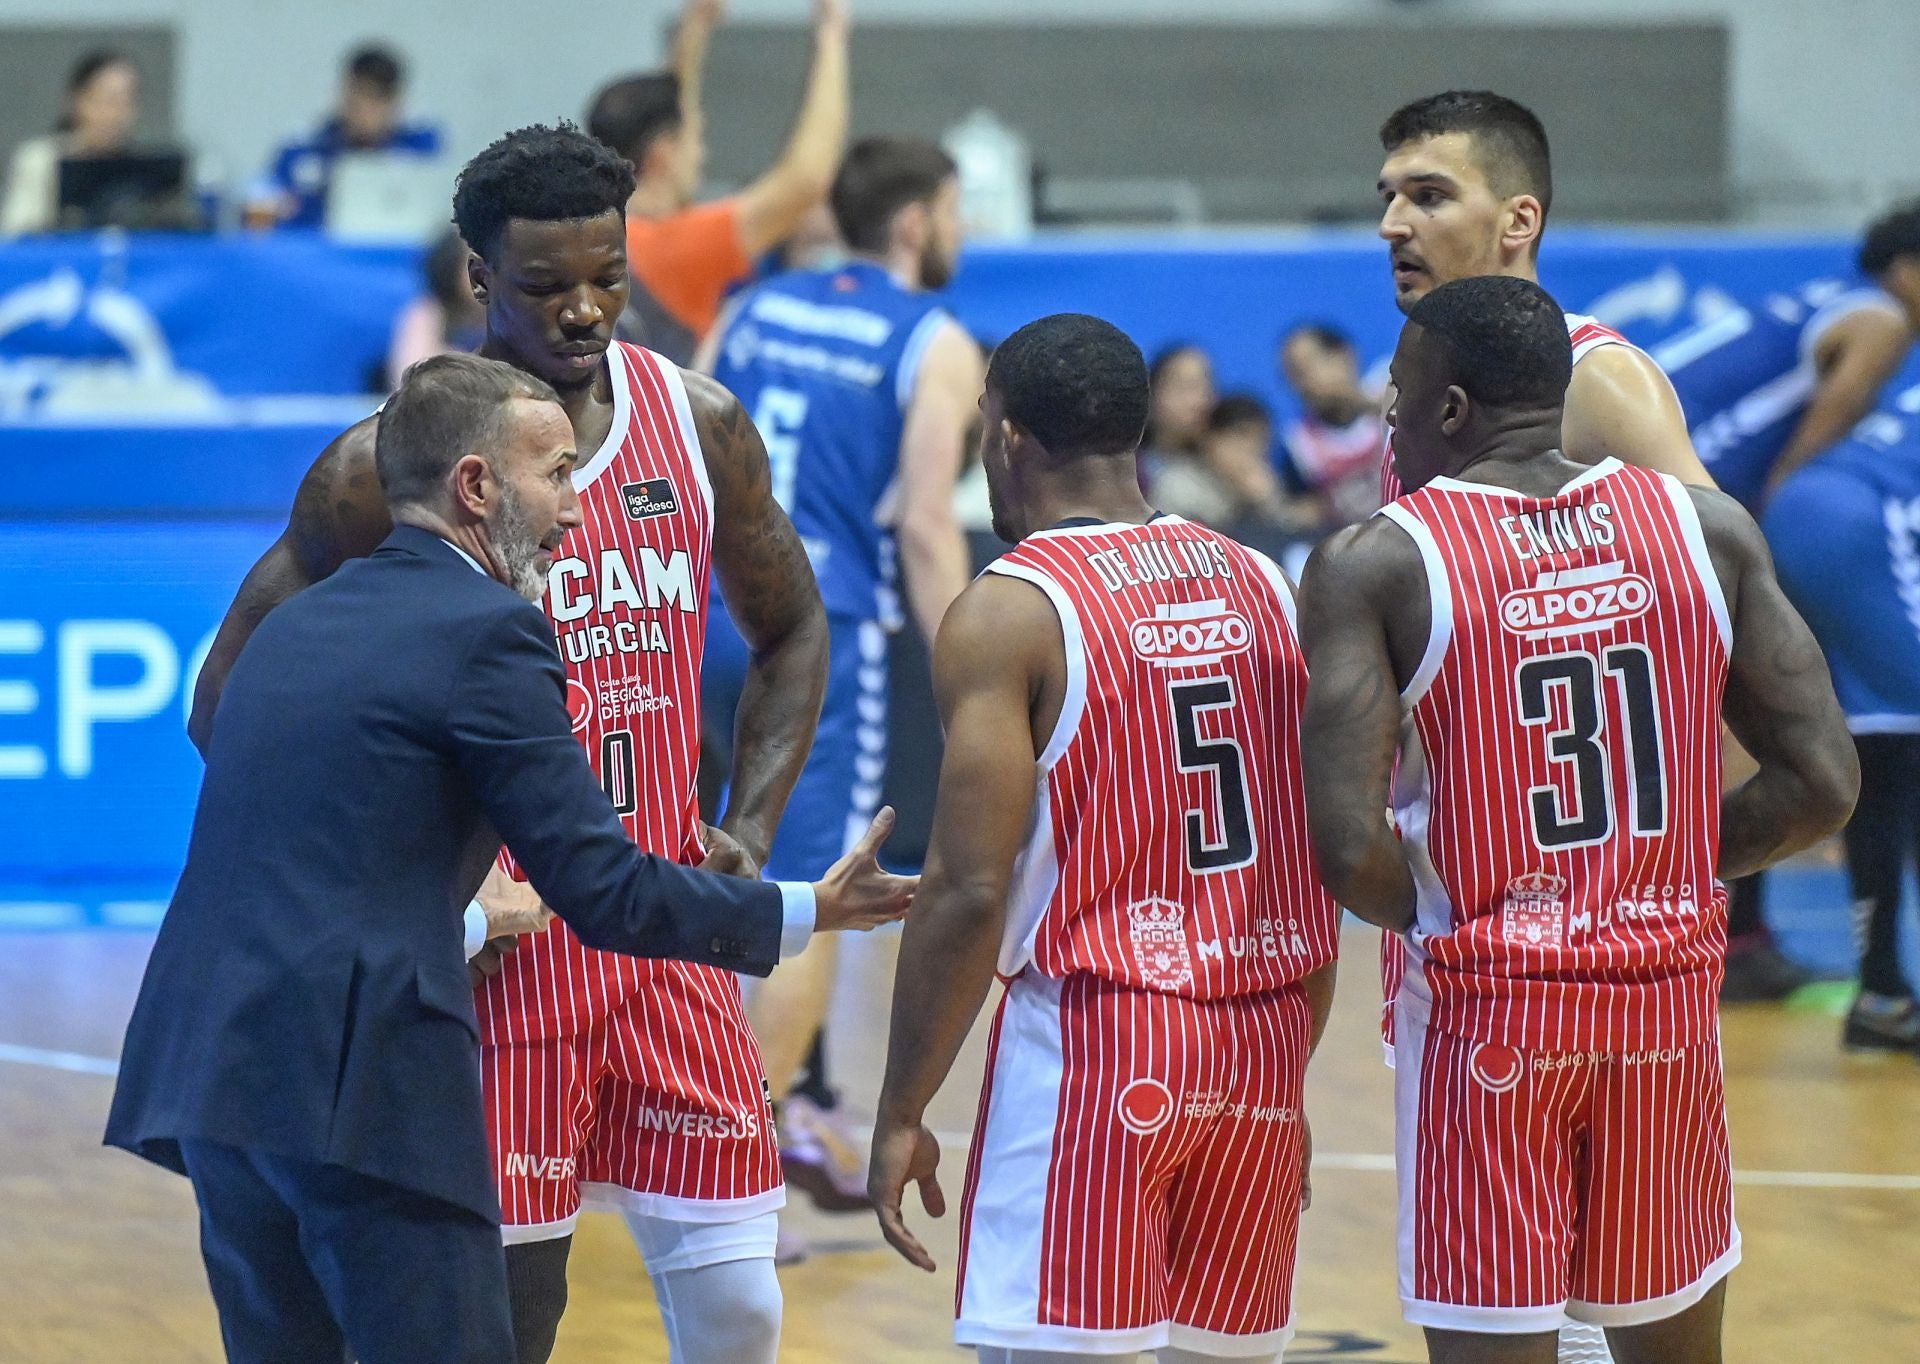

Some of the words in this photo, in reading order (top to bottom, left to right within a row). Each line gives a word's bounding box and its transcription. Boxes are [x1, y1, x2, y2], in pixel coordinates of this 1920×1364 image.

[627, 494, 649, 506] liga
[632, 500, 674, 515] endesa
[1498, 502, 1616, 561] ENNIS
[541, 546, 696, 623] CAM
[1086, 539, 1232, 593] DEJULIUS
[555, 620, 671, 665] URCIA
[601, 704, 622, 720] DE
[624, 695, 674, 717] MURCIA
[1514, 642, 1669, 853] 31
[1167, 674, 1259, 875] 5
[1568, 898, 1700, 936] MURCIA
[1196, 932, 1309, 962] MURCIA
